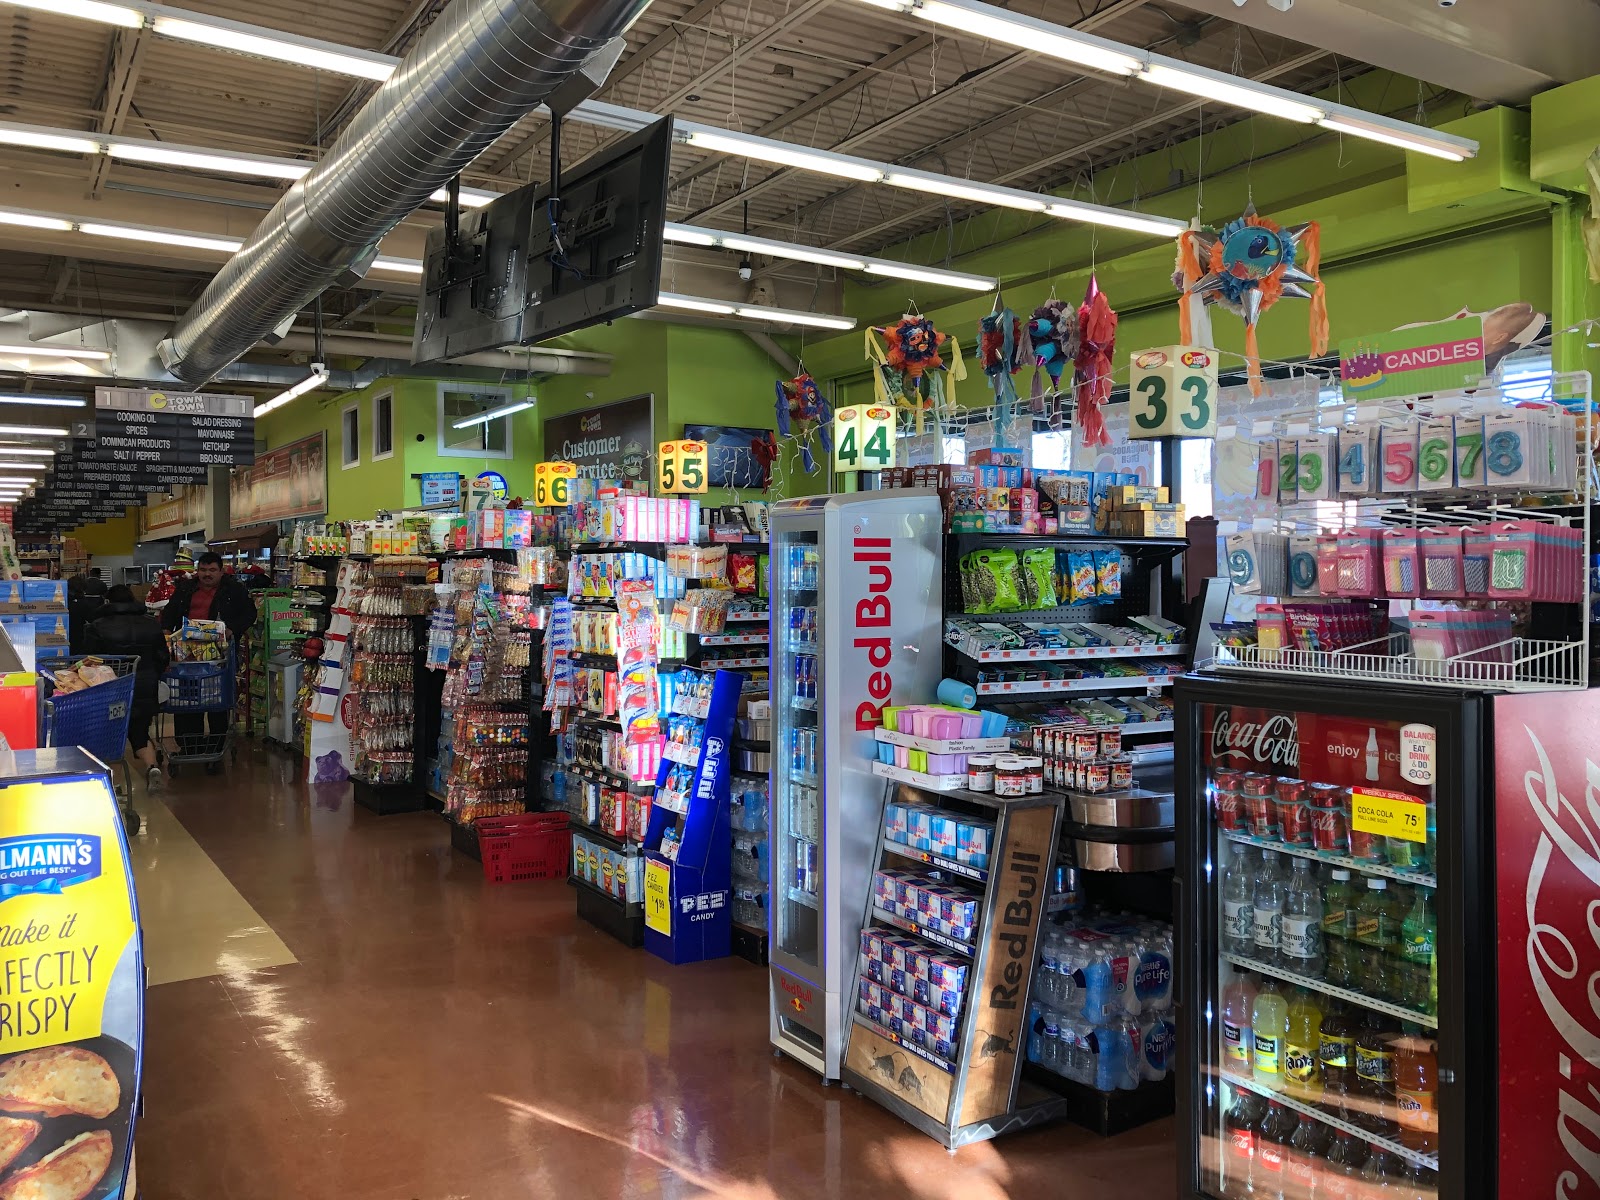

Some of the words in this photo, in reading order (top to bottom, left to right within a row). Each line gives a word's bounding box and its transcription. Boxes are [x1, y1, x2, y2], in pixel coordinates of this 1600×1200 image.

[1385, 342, 1480, 371] CANDLES
[104, 392, 111, 406] 1
[1135, 376, 1167, 430] 3
[1181, 376, 1210, 430] 3
[240, 400, 246, 413] 1
[117, 412, 145, 423] COOKING
[147, 414, 157, 424] OIL
[192, 417, 212, 427] SALAD
[212, 418, 241, 428] DRESSING
[78, 424, 87, 435] 2
[126, 425, 148, 435] SPICES
[198, 429, 234, 439] MAYONNAISE
[59, 441, 65, 451] 3
[102, 437, 136, 447] DOMINICAN
[137, 438, 170, 449] PRODUCTS
[203, 442, 230, 451] KETCHUP
[562, 435, 621, 460] Customer
[839, 427, 858, 465] 4
[864, 426, 890, 464] 4
[114, 450, 129, 460] SALT
[136, 451, 160, 461] PEPPER
[200, 454, 213, 463] BBQ
[214, 454, 233, 464] SAUCE
[77, 462, 99, 470] TOMATO
[100, 463, 116, 471] PASTE
[146, 465, 174, 473] SPAGHETTI
[178, 466, 204, 474] MACARONI
[576, 458, 615, 480] ervice
[84, 473, 112, 481] PREPARED
[112, 474, 130, 482] FOODS
[158, 475, 178, 483] CANNED
[663, 458, 674, 489] 5
[682, 458, 703, 489] 5
[953, 476, 973, 484] TREATS
[537, 478, 546, 503] 6
[552, 477, 567, 503] 6
[473, 491, 489, 510] 7
[853, 538, 892, 627] Bull
[945, 633, 965, 641] eclipse
[853, 637, 892, 731] Red
[1404, 731, 1436, 740] BALANCE
[1327, 743, 1359, 758] enjoy
[1409, 752, 1430, 761] DRINK
[697, 736, 724, 799] PEZ
[1361, 789, 1386, 798] WEEKLY
[1387, 792, 1414, 802] SPECIAL
[1358, 806, 1374, 814] COCA
[1376, 810, 1393, 818] COLA
[971, 841, 982, 849] Bull
[10, 869, 29, 878] OUT
[647, 881, 663, 894] CANDIES
[1004, 852, 1041, 927] Bull
[680, 891, 725, 913] PEZ
[691, 912, 715, 921] CANDY
[59, 913, 78, 939] it
[1406, 944, 1432, 954] Sprite
[989, 933, 1027, 1010] Red
[1136, 972, 1152, 986] Pure
[1153, 970, 1169, 982] Life
